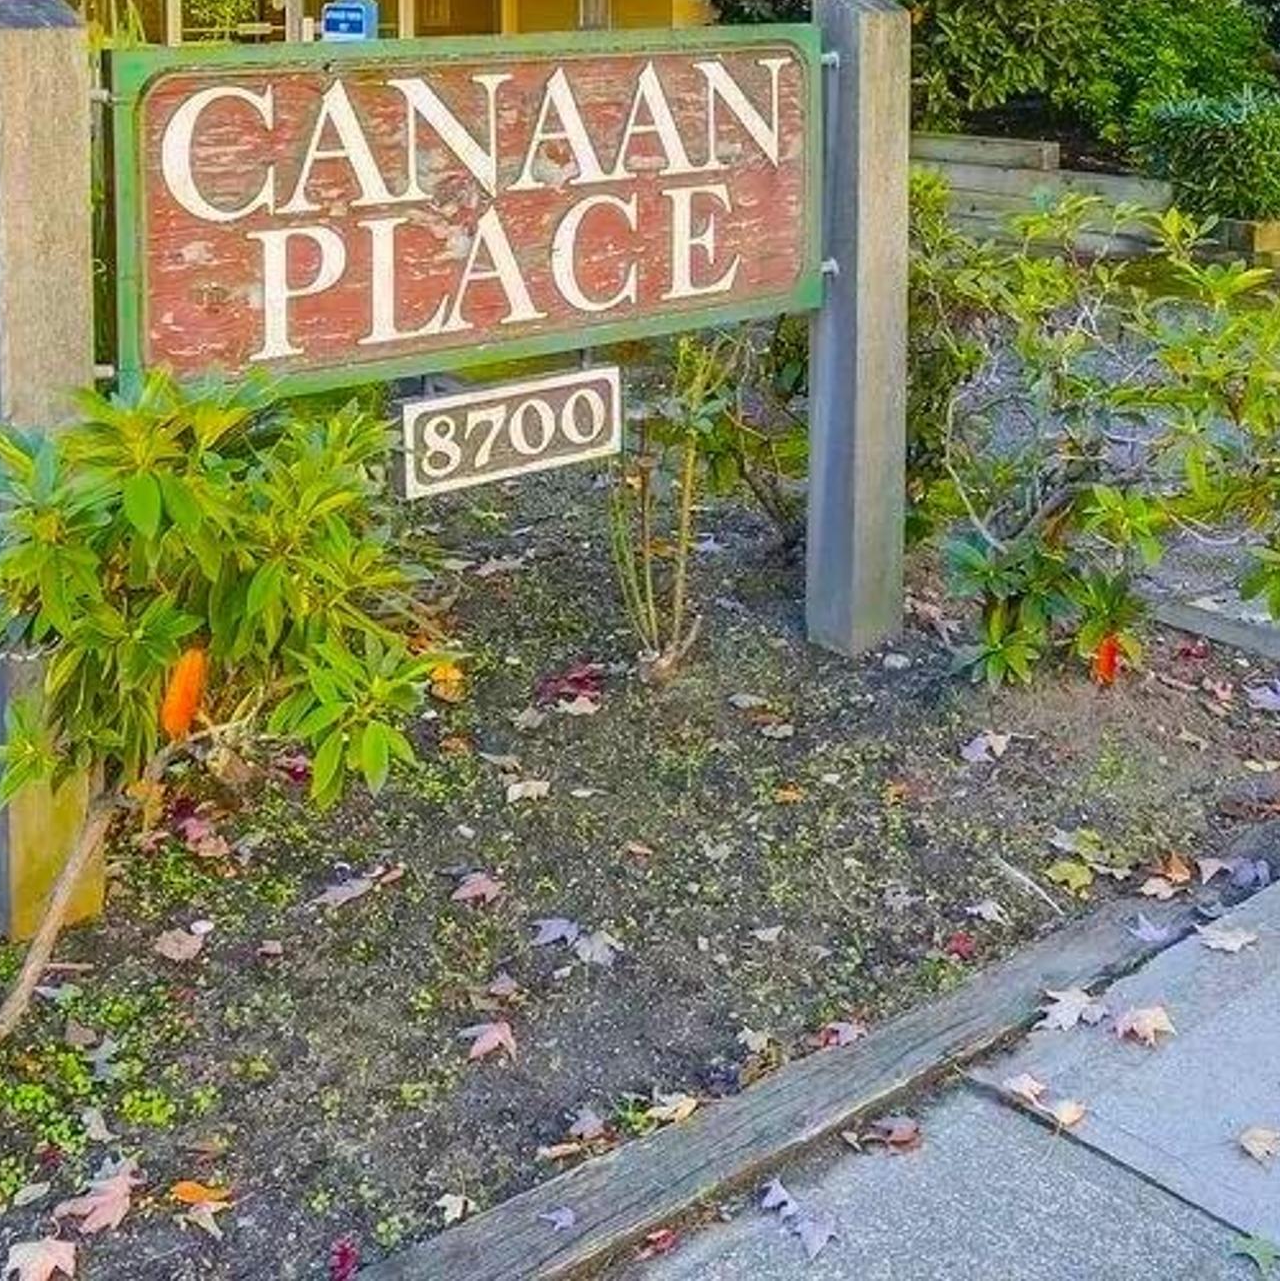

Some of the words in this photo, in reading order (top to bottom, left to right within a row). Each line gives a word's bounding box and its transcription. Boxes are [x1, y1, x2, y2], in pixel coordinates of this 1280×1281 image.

[161, 58, 791, 220] CANAAN
[248, 184, 740, 361] PLACE
[422, 389, 605, 477] 8700
